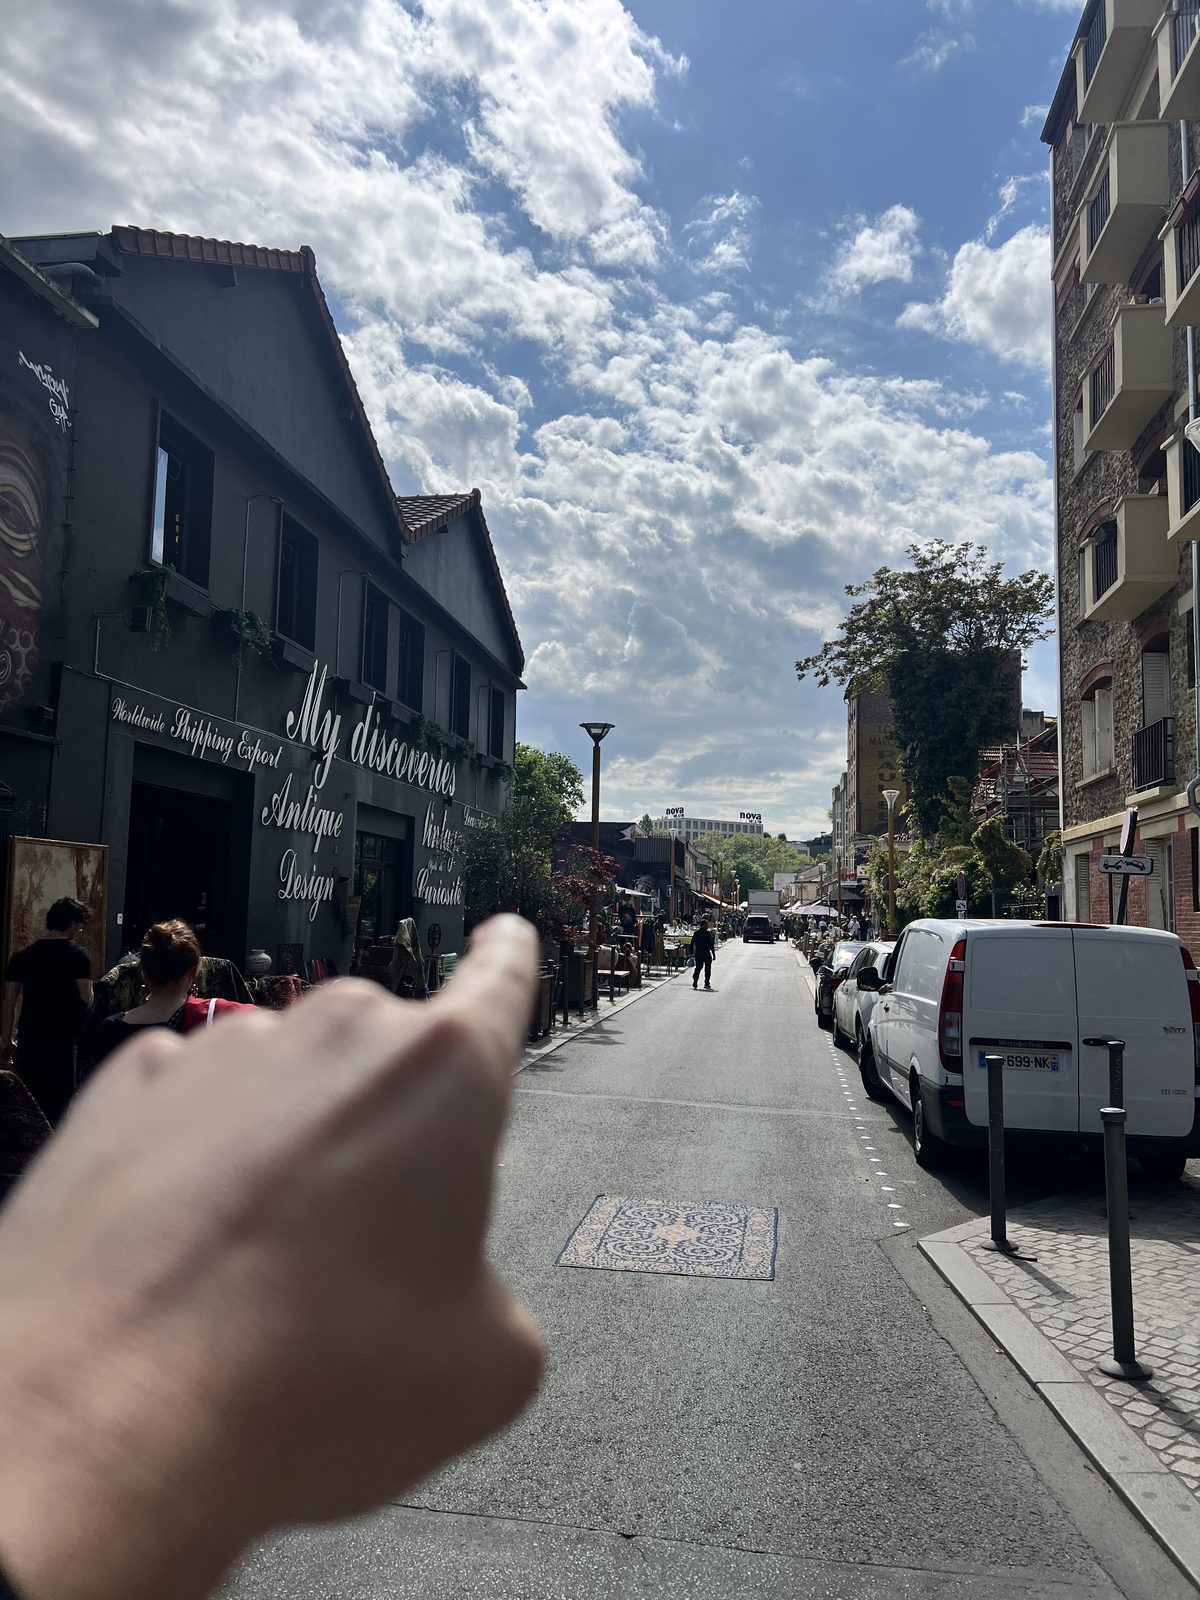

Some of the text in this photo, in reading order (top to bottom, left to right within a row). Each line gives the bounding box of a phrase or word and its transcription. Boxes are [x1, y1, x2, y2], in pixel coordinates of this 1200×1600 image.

[112, 697, 283, 772] Worldwide Shipping Export
[286, 659, 456, 797] My discoveries
[261, 772, 344, 853] Antique
[665, 806, 684, 815] nova
[739, 812, 762, 820] nova
[278, 849, 334, 922] Design
[1003, 1054, 1050, 1069] -699-NK
